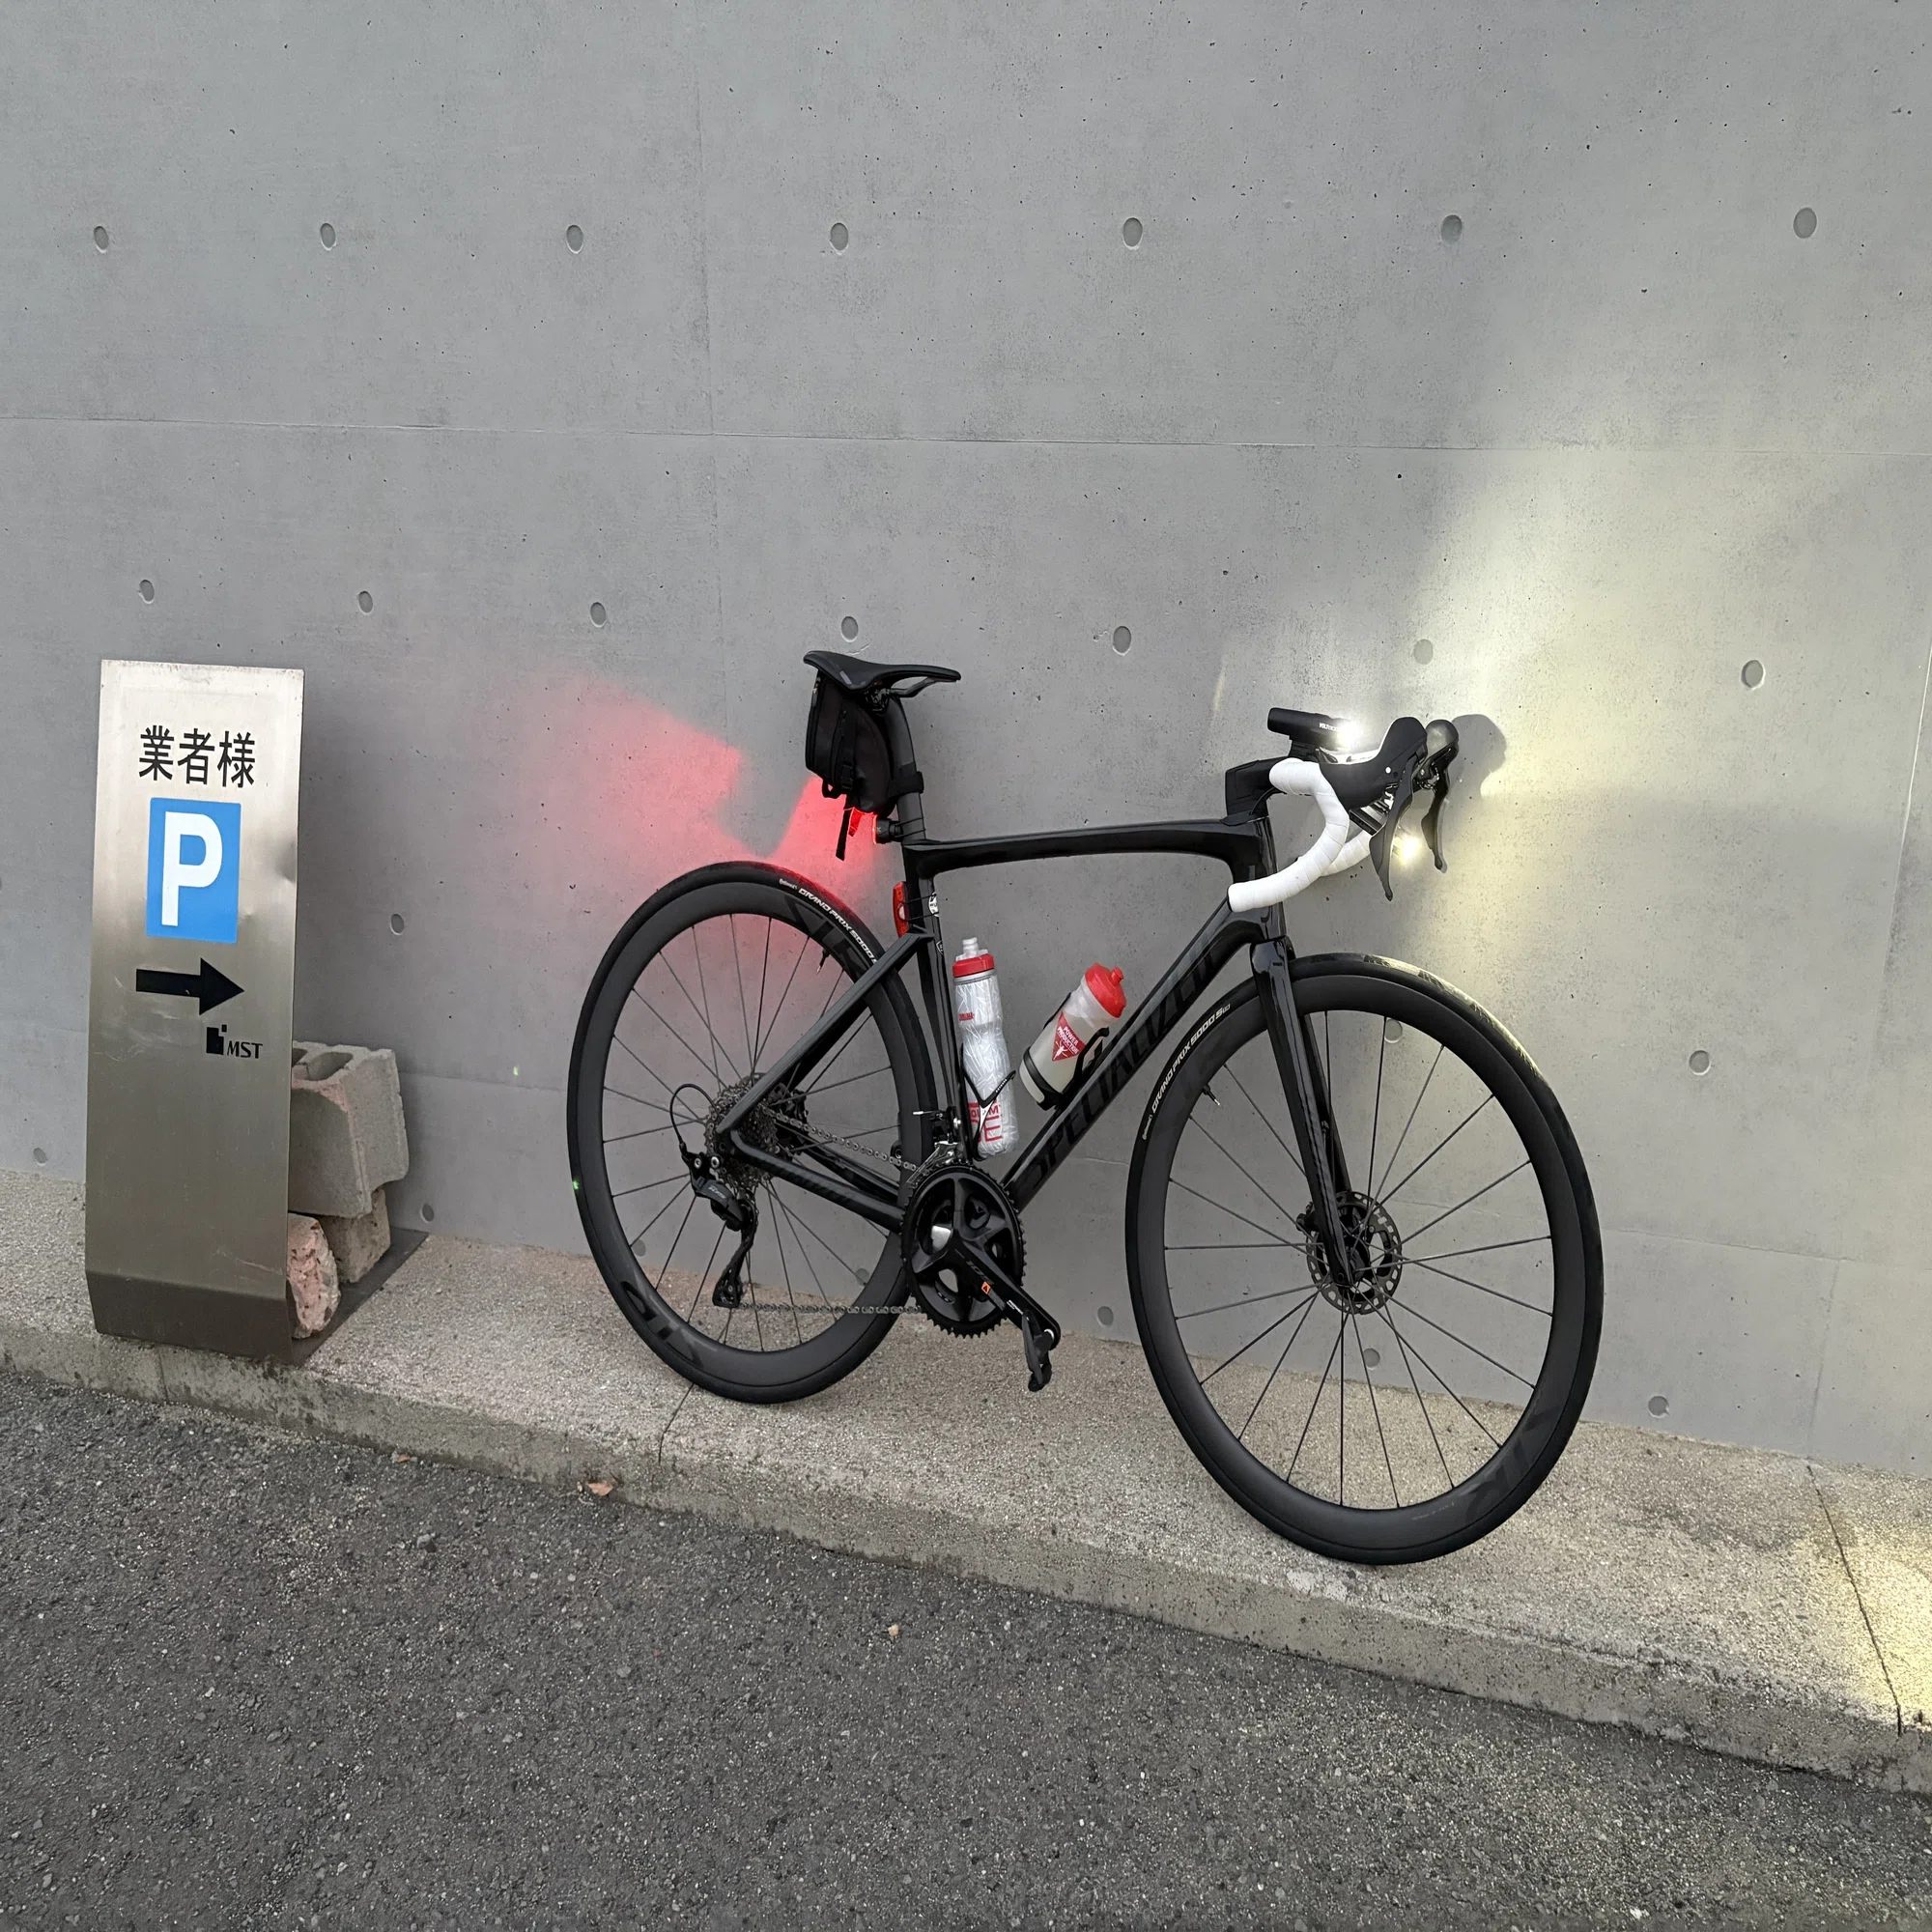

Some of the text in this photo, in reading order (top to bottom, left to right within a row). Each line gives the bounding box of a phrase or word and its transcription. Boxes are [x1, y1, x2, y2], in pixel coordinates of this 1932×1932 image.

[139, 724, 256, 788] 業者様
[161, 810, 223, 927] P
[799, 888, 874, 958] GRAND PRIX 5000
[227, 1040, 263, 1059] MST
[1064, 1026, 1078, 1046] POWER
[1151, 1068, 1174, 1113] GRAND
[1172, 1041, 1191, 1072] PRIX
[1190, 1014, 1214, 1045] 5000
